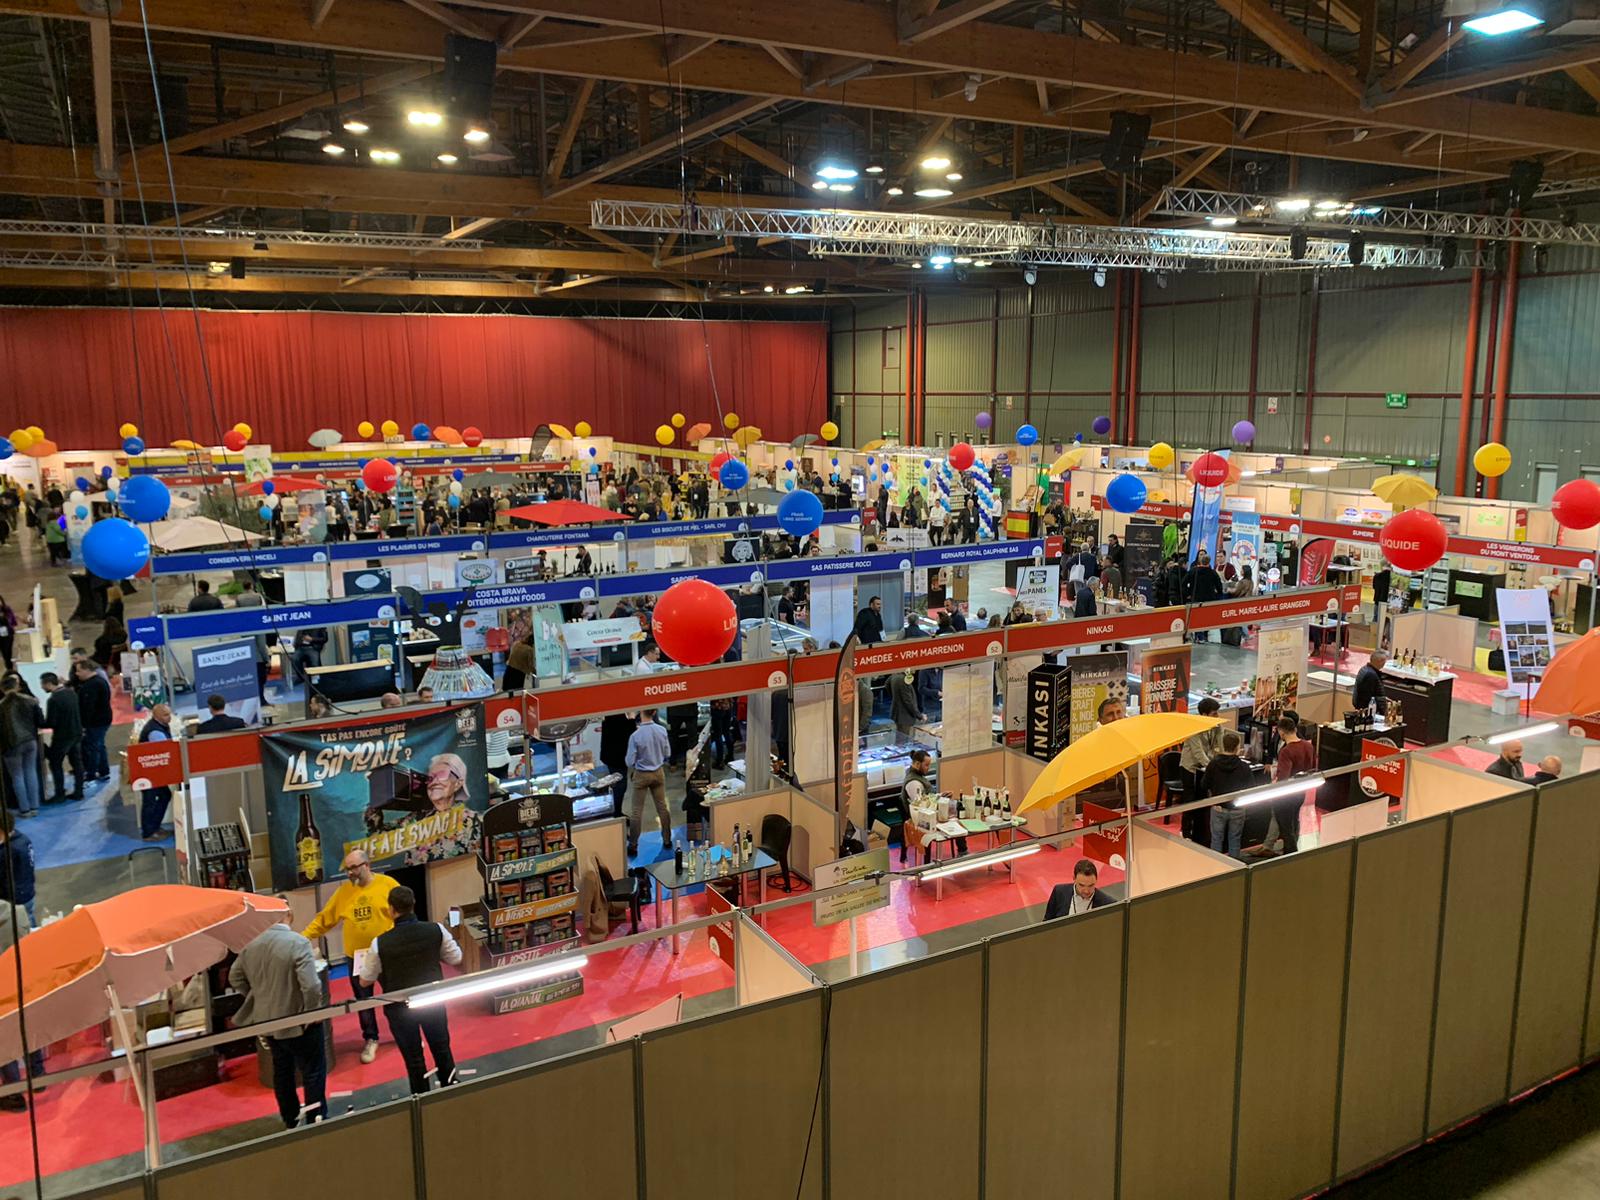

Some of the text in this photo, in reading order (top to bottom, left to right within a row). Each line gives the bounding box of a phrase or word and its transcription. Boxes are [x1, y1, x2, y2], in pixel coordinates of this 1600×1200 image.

[526, 532, 589, 543] CHARCUTERIE FONTANA
[378, 545, 390, 553] LES
[390, 543, 418, 551] PLAISIRS
[1381, 538, 1420, 551] LIQUIDE
[1486, 542, 1535, 553] LES VIGNERONS
[255, 553, 277, 561] MICELI
[941, 546, 1019, 560] BERNARD ROYAL DAUPHINE SAS
[1480, 548, 1541, 561] DU MONT VENTOUX
[811, 560, 872, 572] SAS PATISSERIE ROCCI
[475, 586, 527, 599] COSTA BRAVA
[521, 592, 546, 602] FOODS
[1221, 599, 1311, 619] EURL MARIE-LAURE GRANGEON
[262, 611, 311, 624] SAINT JEAN
[1086, 624, 1114, 636] NINKASI
[859, 652, 893, 666] AMEDEE
[900, 649, 919, 660] VRM
[920, 643, 964, 658] MARRENON
[1152, 664, 1177, 673] NINKASI
[773, 675, 782, 685] 53
[1080, 671, 1110, 679] NINKASI
[644, 681, 688, 696] ROUBINE
[1145, 678, 1177, 693] BRASSERIE
[1072, 699, 1094, 710] CRAFT
[456, 717, 477, 729] BEER
[503, 715, 514, 725] 54
[338, 731, 353, 740] PAS
[354, 727, 384, 739] ENCORE
[138, 751, 171, 763] DOMAINE
[141, 758, 169, 768] TROPEZ
[282, 750, 323, 792] LA
[404, 747, 412, 760] ?
[1389, 766, 1398, 775] SC
[408, 813, 449, 842] SWAG
[353, 906, 372, 918] BEER
